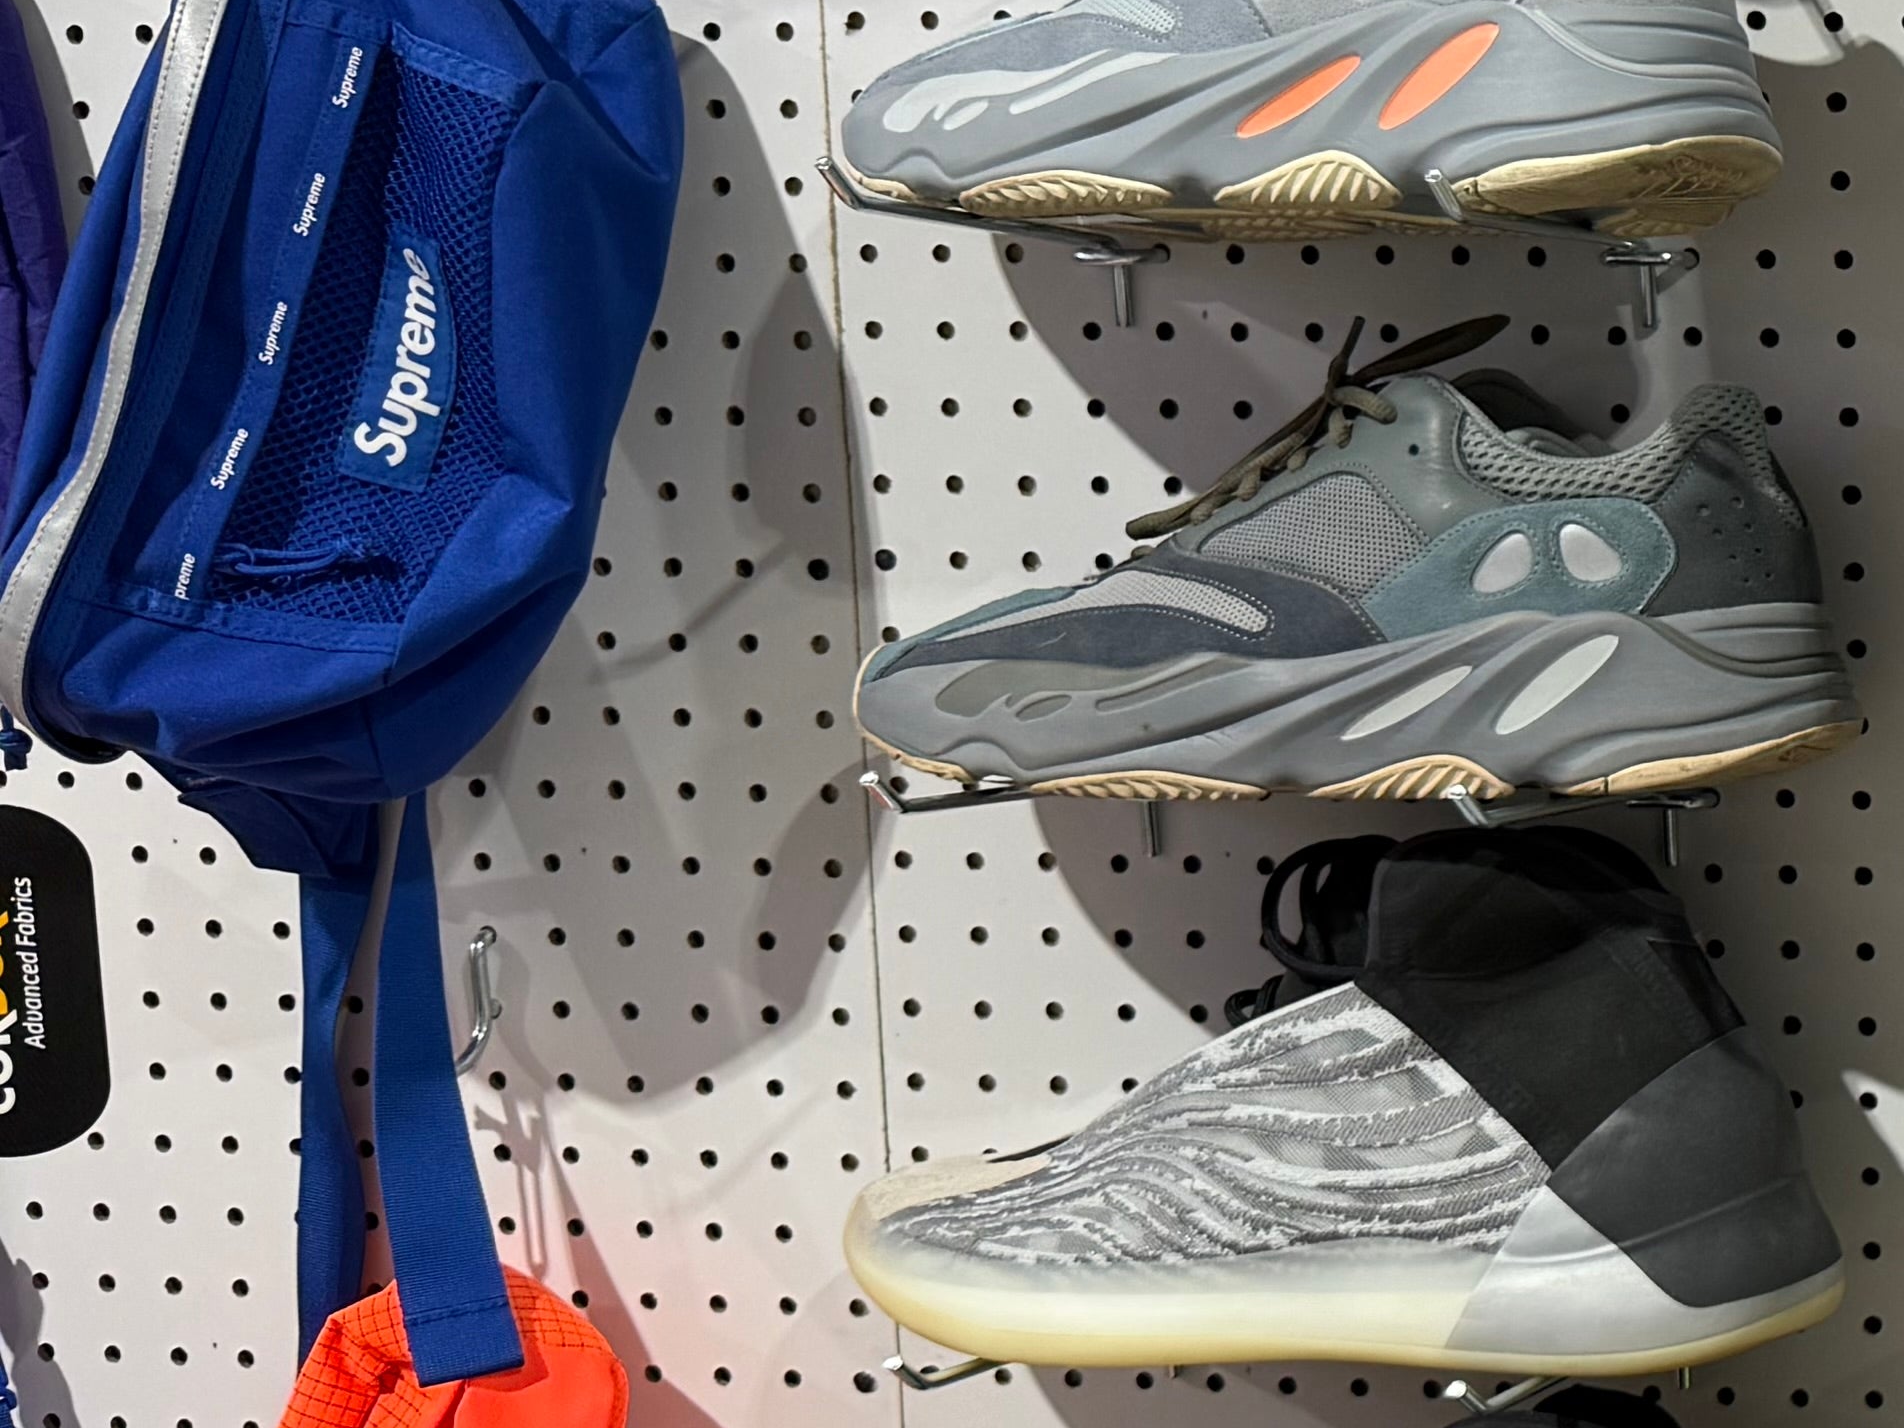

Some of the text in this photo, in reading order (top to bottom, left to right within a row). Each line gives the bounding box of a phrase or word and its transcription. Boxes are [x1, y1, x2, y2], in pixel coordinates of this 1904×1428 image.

[331, 45, 364, 110] Supreme
[292, 171, 326, 238] Supreme
[257, 300, 289, 367] Supreme
[352, 246, 443, 468] Supreme
[210, 427, 250, 491] Supreme
[10, 876, 47, 1050] Advanced Fabrics
